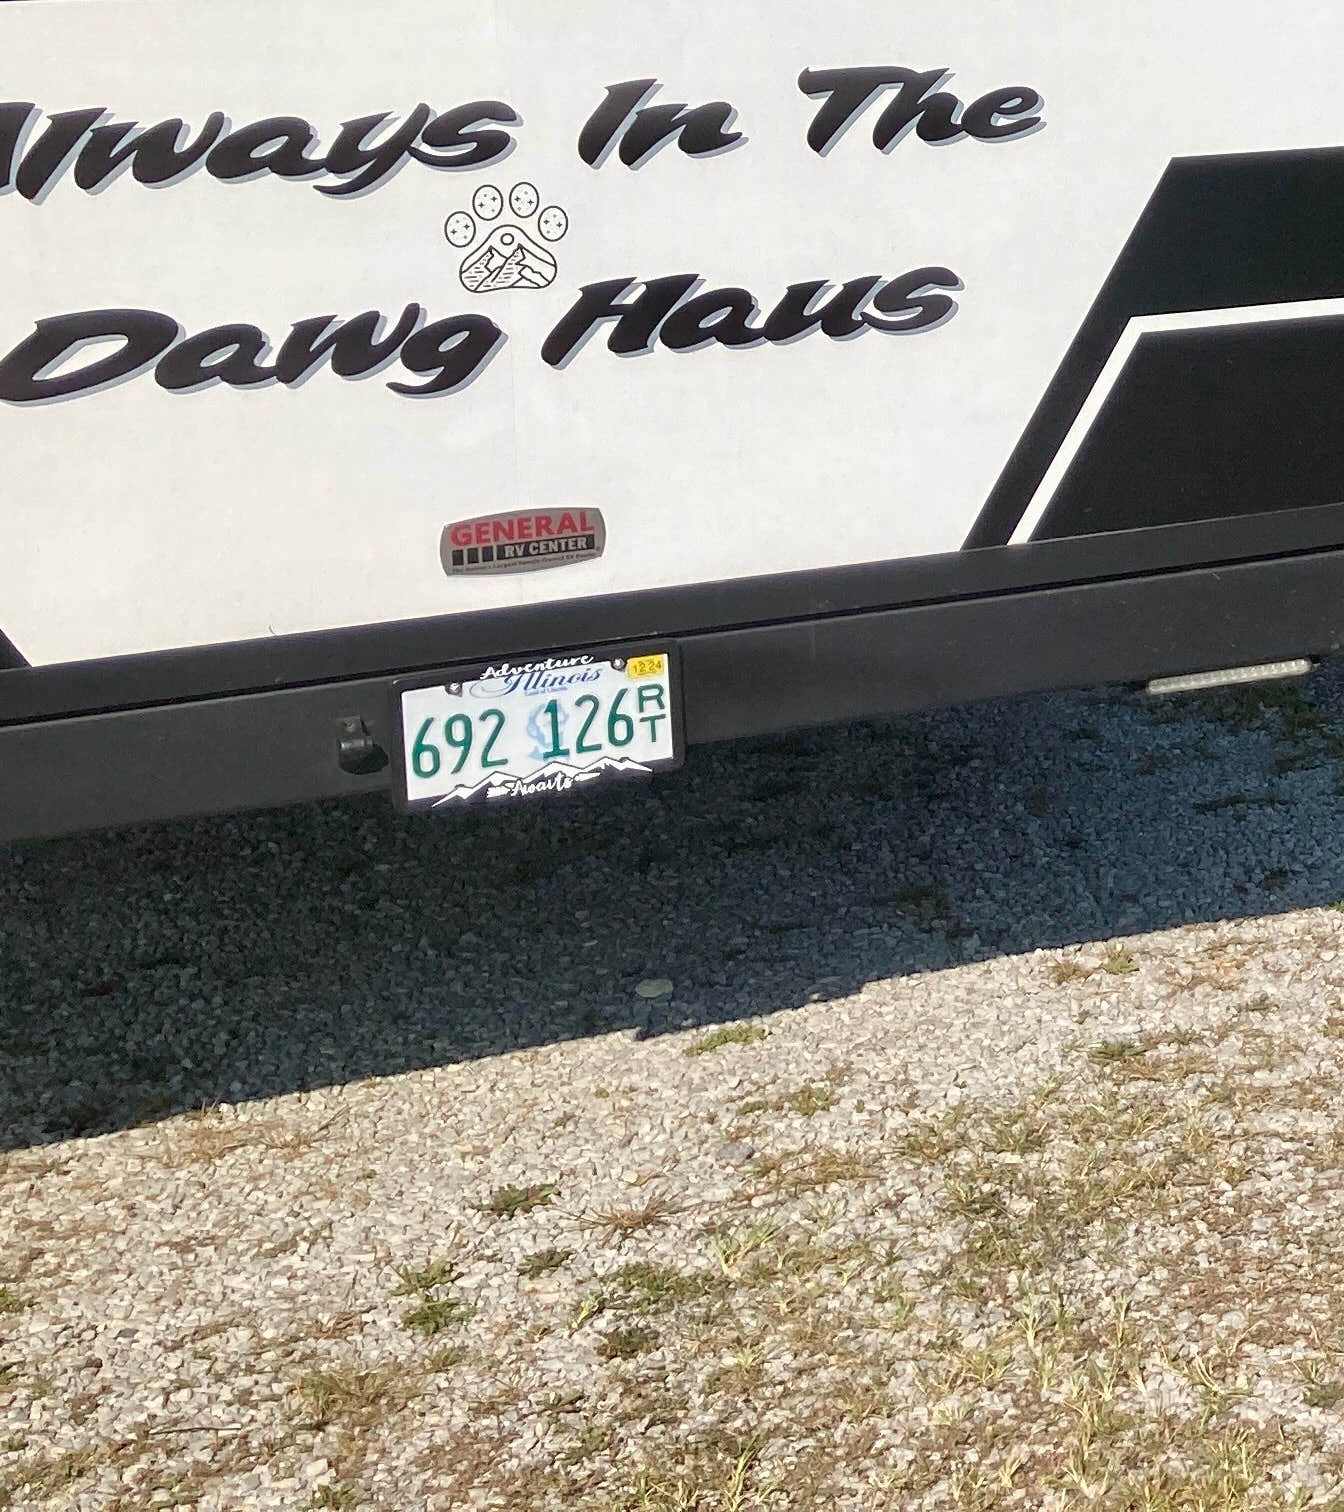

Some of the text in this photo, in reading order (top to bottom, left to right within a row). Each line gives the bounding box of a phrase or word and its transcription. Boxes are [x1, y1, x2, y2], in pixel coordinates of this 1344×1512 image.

[577, 77, 749, 171] In
[797, 65, 1047, 158] The
[0, 265, 965, 406] Dawg Haus
[451, 510, 596, 547] GENERAL
[503, 537, 588, 558] RV CENTER
[476, 666, 603, 698] Illinois
[480, 654, 594, 680] Adventure
[411, 707, 508, 779] 692
[541, 688, 635, 760] 126
